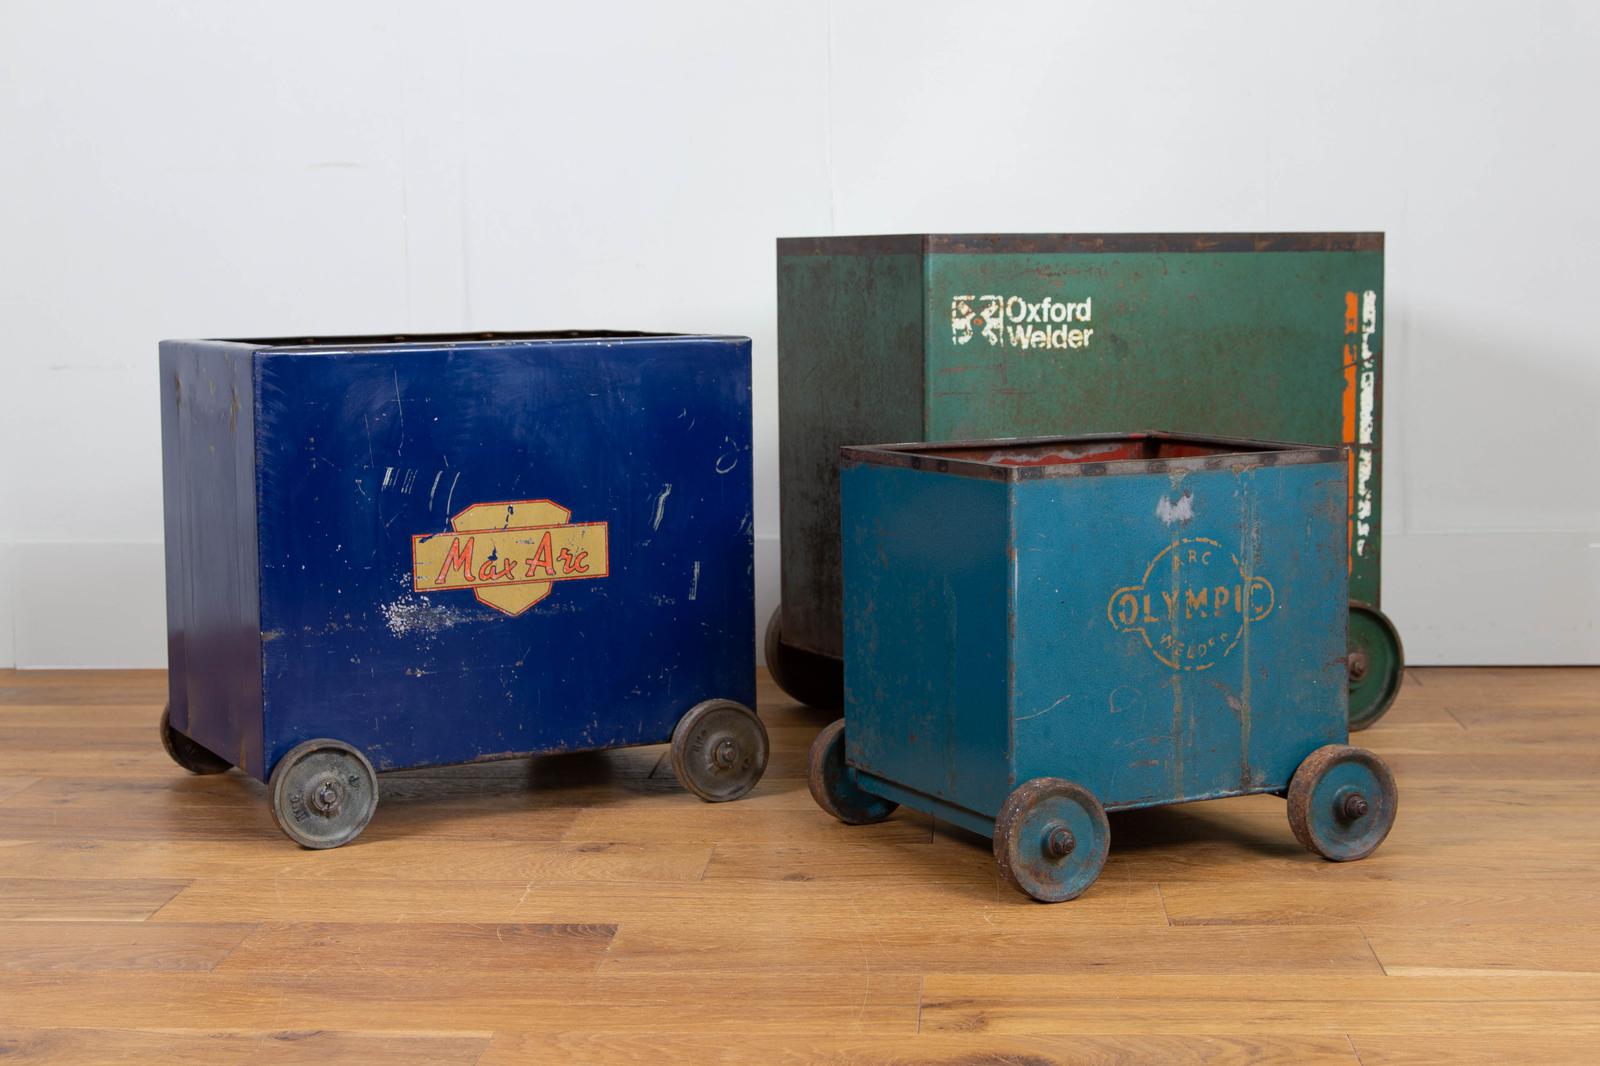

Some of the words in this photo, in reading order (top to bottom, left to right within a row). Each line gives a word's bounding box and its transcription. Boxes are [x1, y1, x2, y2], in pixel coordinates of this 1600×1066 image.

[1006, 295, 1092, 323] Oxford
[1006, 324, 1094, 349] Welder
[435, 536, 517, 585] Max
[525, 531, 590, 577] Arc
[1118, 584, 1264, 625] OLYMPIC
